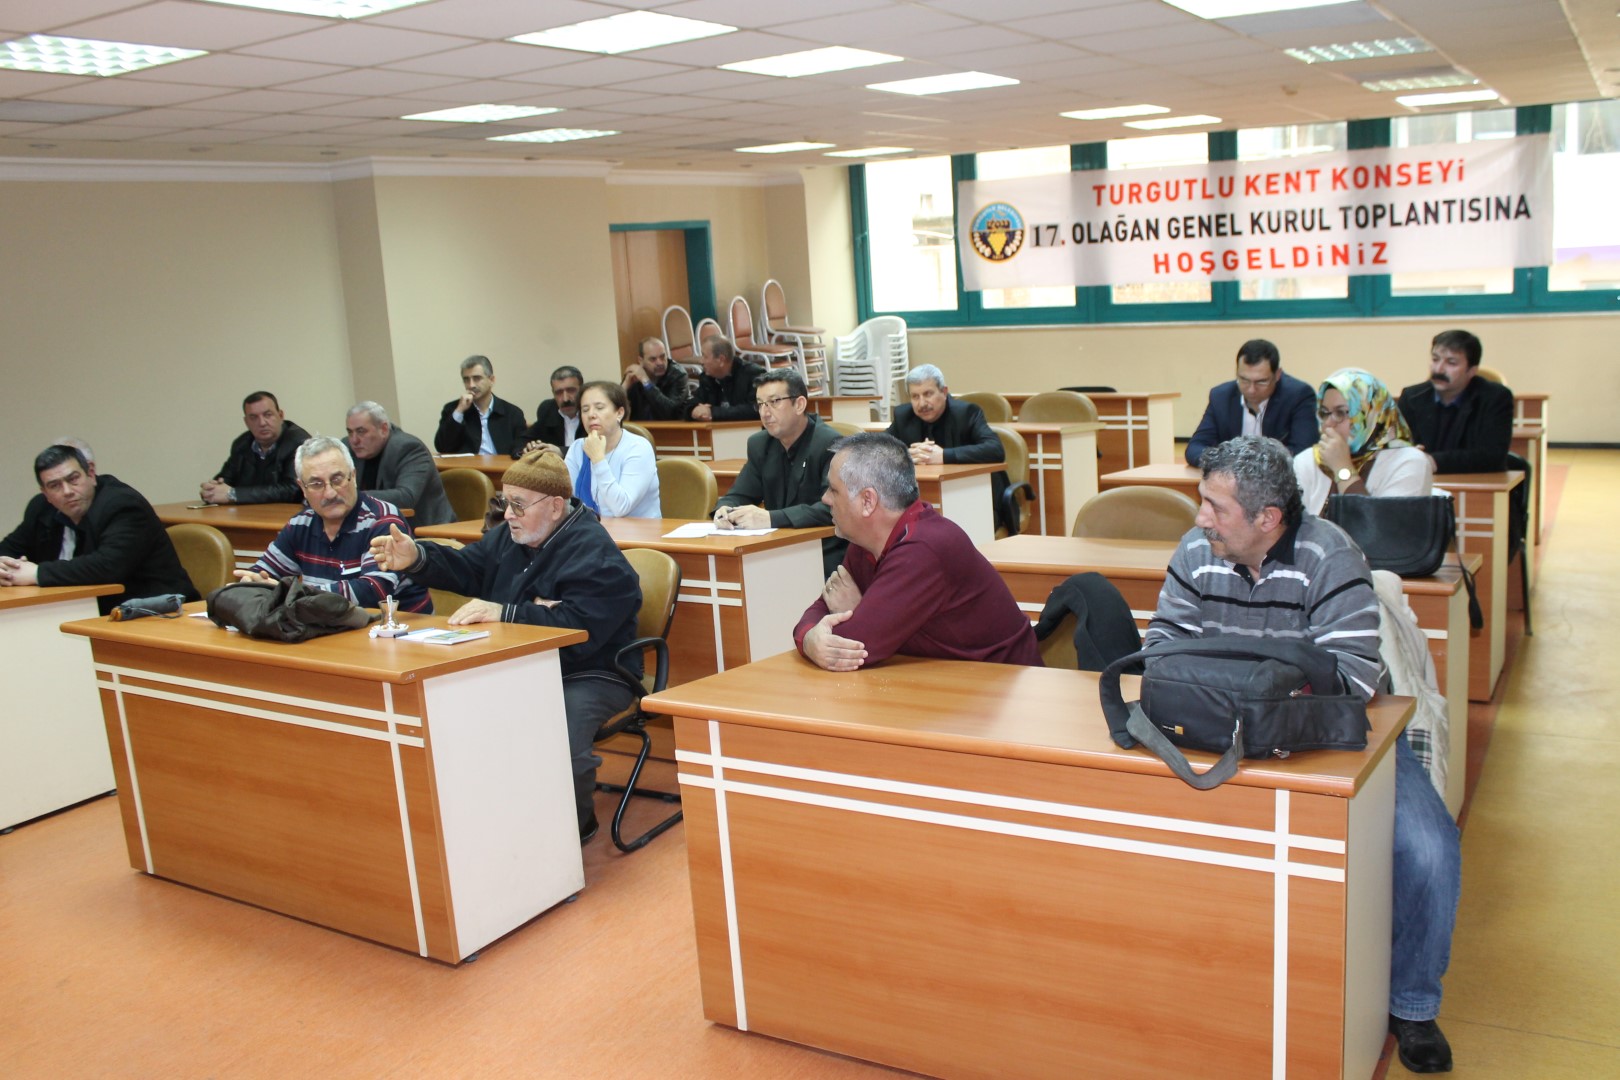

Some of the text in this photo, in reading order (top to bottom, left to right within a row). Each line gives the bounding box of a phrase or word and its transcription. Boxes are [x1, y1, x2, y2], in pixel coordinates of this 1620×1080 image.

[1092, 175, 1235, 206] TURGUTLU
[1244, 168, 1322, 197] KENT
[1032, 194, 1532, 247] 17. OLAĞAN GENEL KURUL TOPLANTISINA
